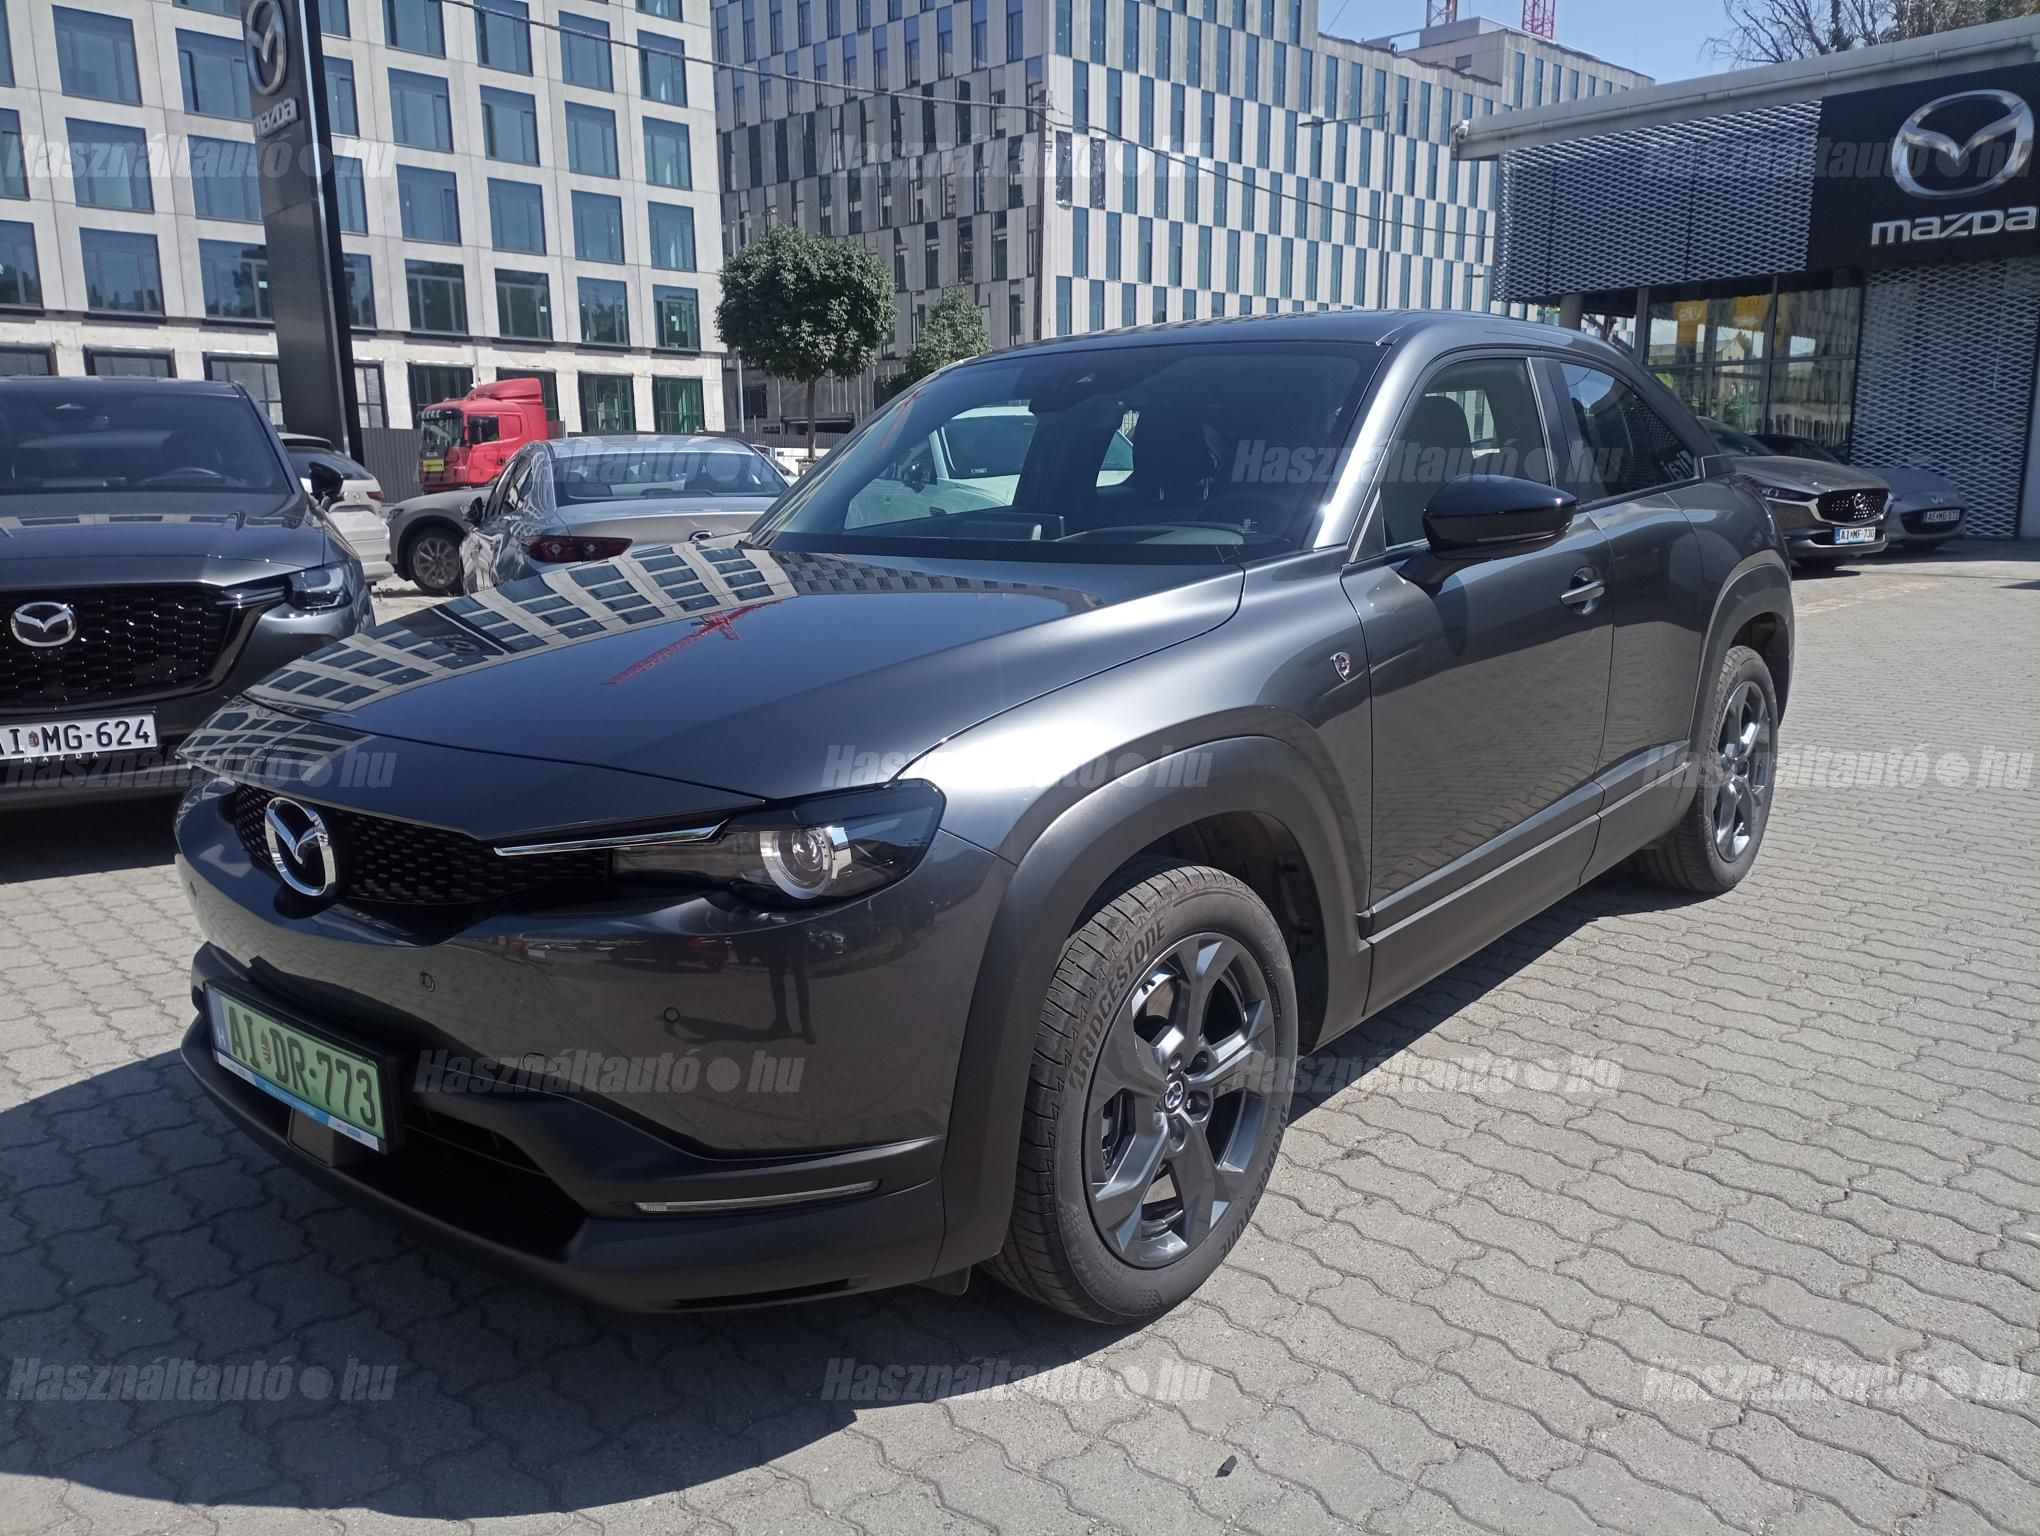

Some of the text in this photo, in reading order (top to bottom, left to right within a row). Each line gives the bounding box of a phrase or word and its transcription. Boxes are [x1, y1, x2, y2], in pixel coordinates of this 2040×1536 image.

[41, 719, 150, 752] MG-624
[1068, 917, 1165, 1093] BRIDGESTONE
[228, 1006, 261, 1070] AI
[269, 1027, 377, 1127] DR-773
